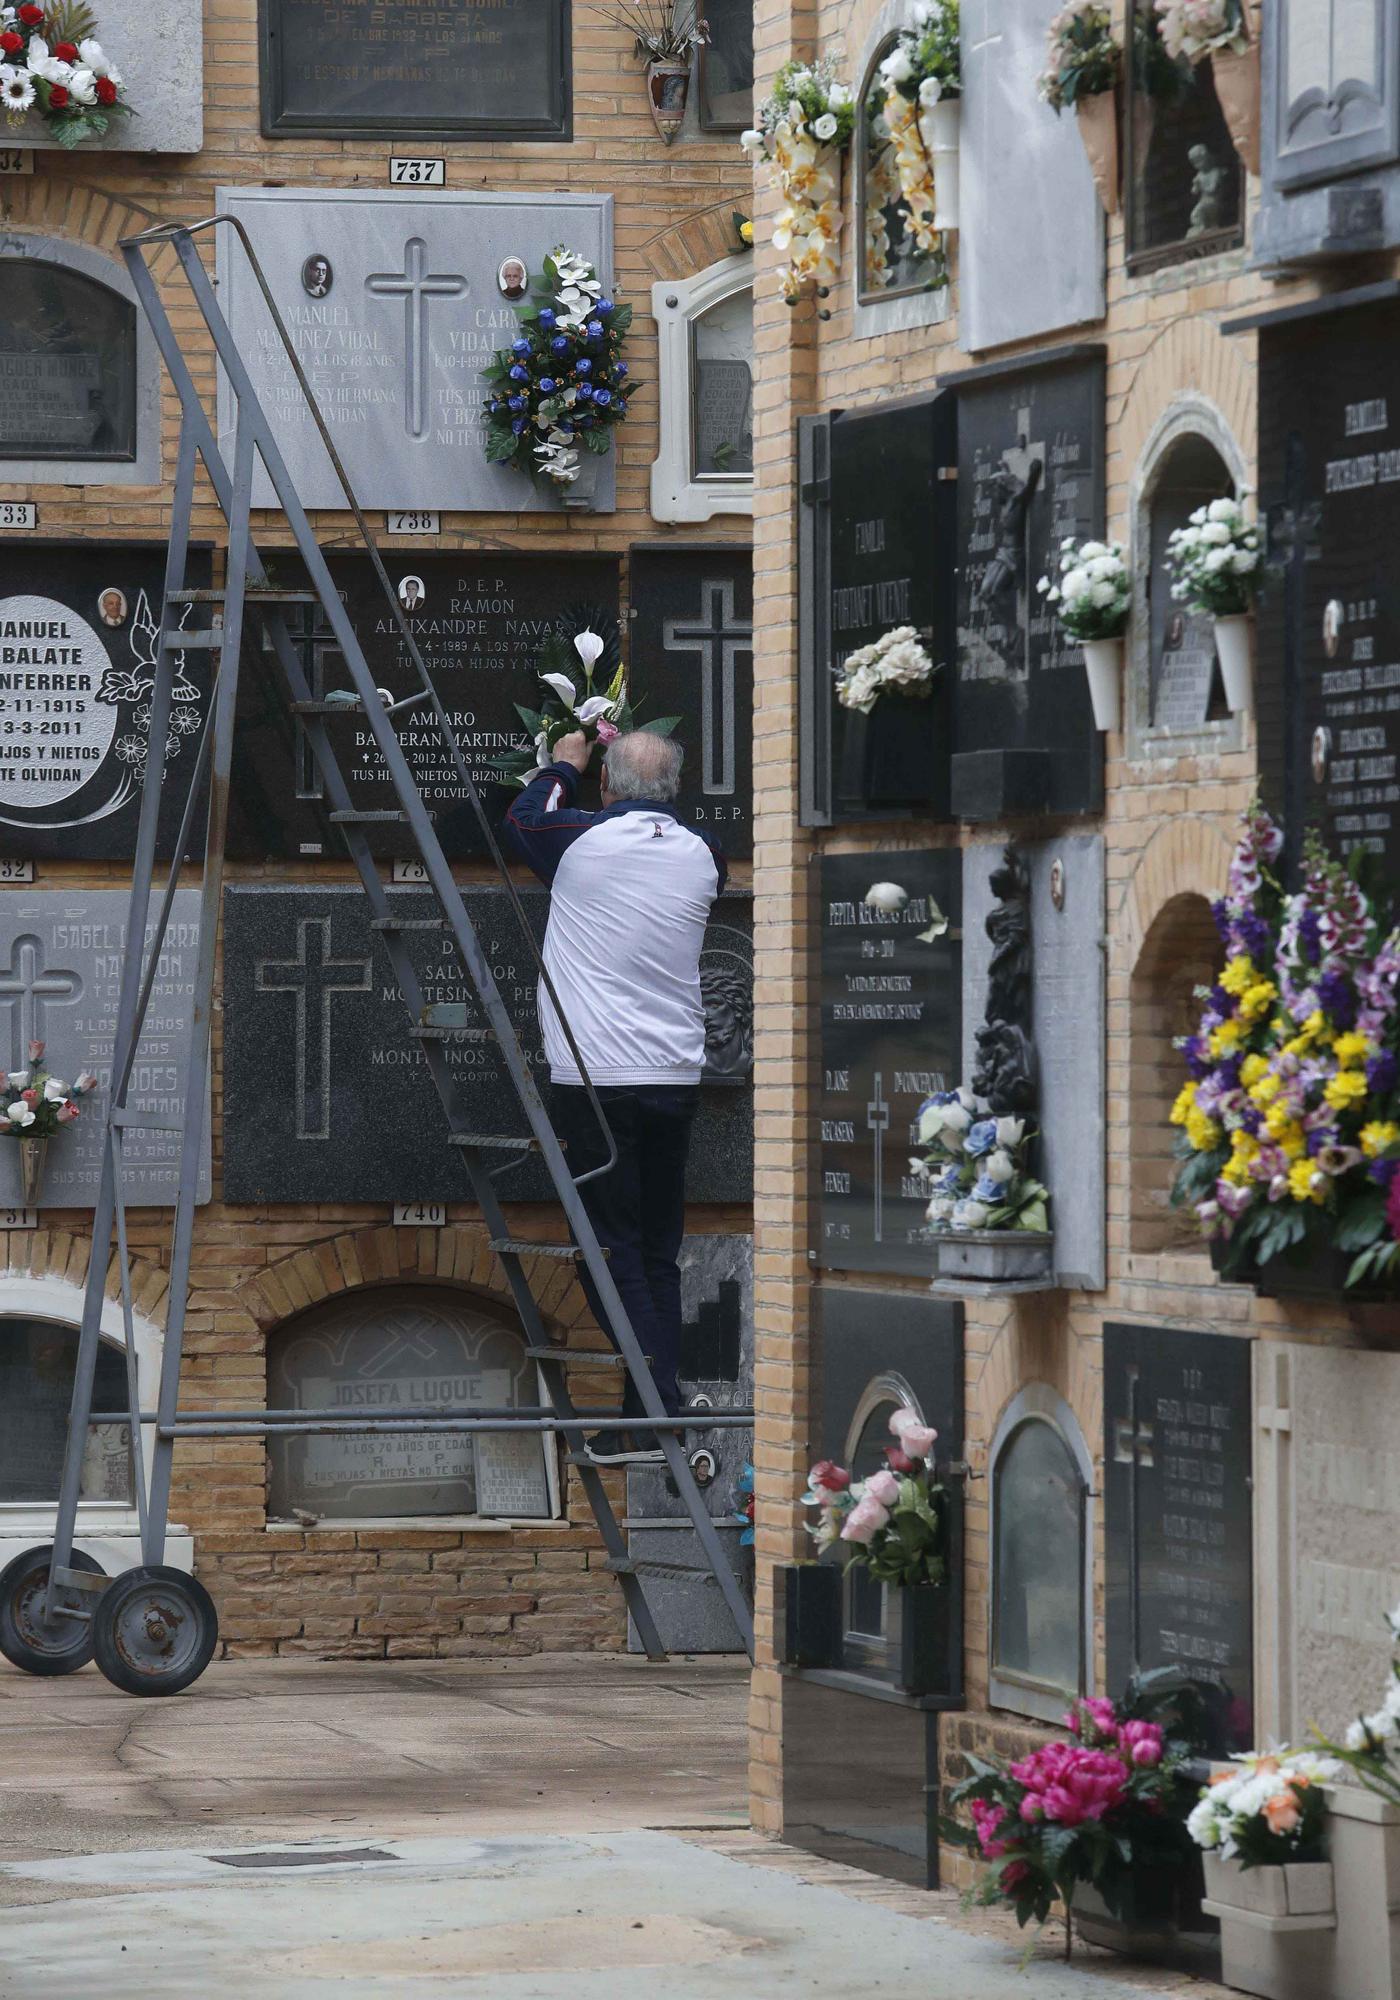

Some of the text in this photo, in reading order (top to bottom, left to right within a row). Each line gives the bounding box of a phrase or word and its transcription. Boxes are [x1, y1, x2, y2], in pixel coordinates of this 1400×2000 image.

[396, 163, 436, 181] 737
[288, 307, 352, 326] MANUEL
[339, 331, 383, 350] VIDAL
[449, 332, 501, 351] VIDAL
[437, 430, 453, 445] NO
[3, 505, 28, 524] 33
[395, 511, 431, 530] 738
[450, 599, 516, 614] RAMON
[0, 621, 72, 639] ANUEL
[487, 641, 509, 652] LOS
[3, 648, 82, 665] BALATE
[470, 657, 505, 669] HIJOS
[37, 746, 46, 759] Y
[51, 747, 100, 759] NIETOS
[439, 754, 447, 764] A
[1, 768, 81, 781] TE OLVIDAN
[351, 769, 458, 781] TUS NIETOS
[695, 807, 745, 820] D. E. P.
[2, 860, 26, 878] 32
[830, 902, 856, 925] PEPITA
[53, 924, 114, 949] ISABEL
[401, 1203, 440, 1222] 740
[330, 1379, 482, 1406] JOSEFA LUQUE
[343, 1446, 350, 1455] A
[353, 1444, 375, 1455] LOS
[380, 1443, 391, 1453] 70
[396, 1440, 424, 1453] AÑOS
[428, 1441, 441, 1451] DE
[372, 1455, 388, 1466] R.
[369, 1469, 375, 1479] Y
[379, 1468, 415, 1478] NIETAS
